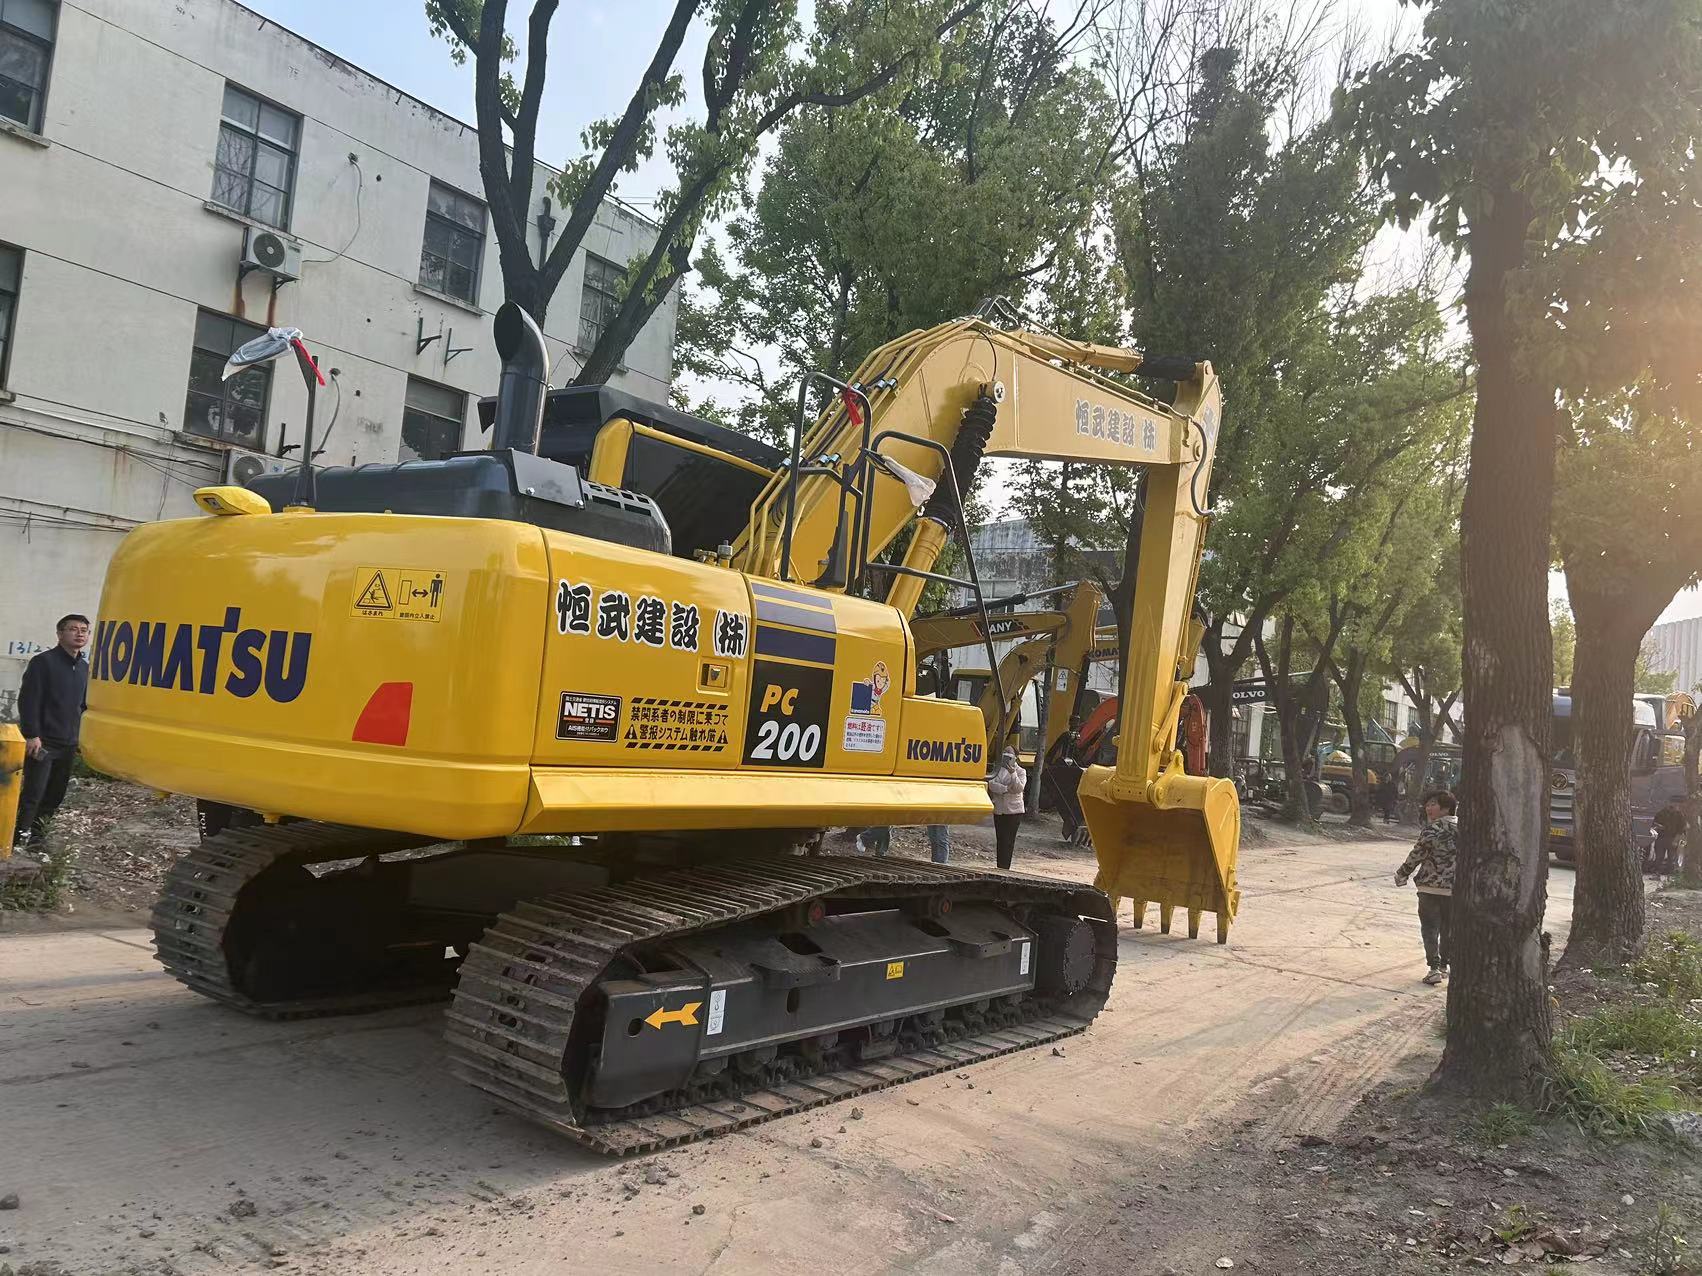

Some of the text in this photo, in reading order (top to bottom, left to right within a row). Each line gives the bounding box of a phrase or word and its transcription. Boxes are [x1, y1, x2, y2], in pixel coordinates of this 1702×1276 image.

[985, 621, 1012, 634] ANY
[92, 607, 312, 702] KOMATSU
[760, 684, 799, 716] PC
[1232, 690, 1265, 699] OLVO
[564, 702, 616, 719] NETIS
[751, 721, 821, 761] 200
[907, 738, 982, 763] KOMATSU
